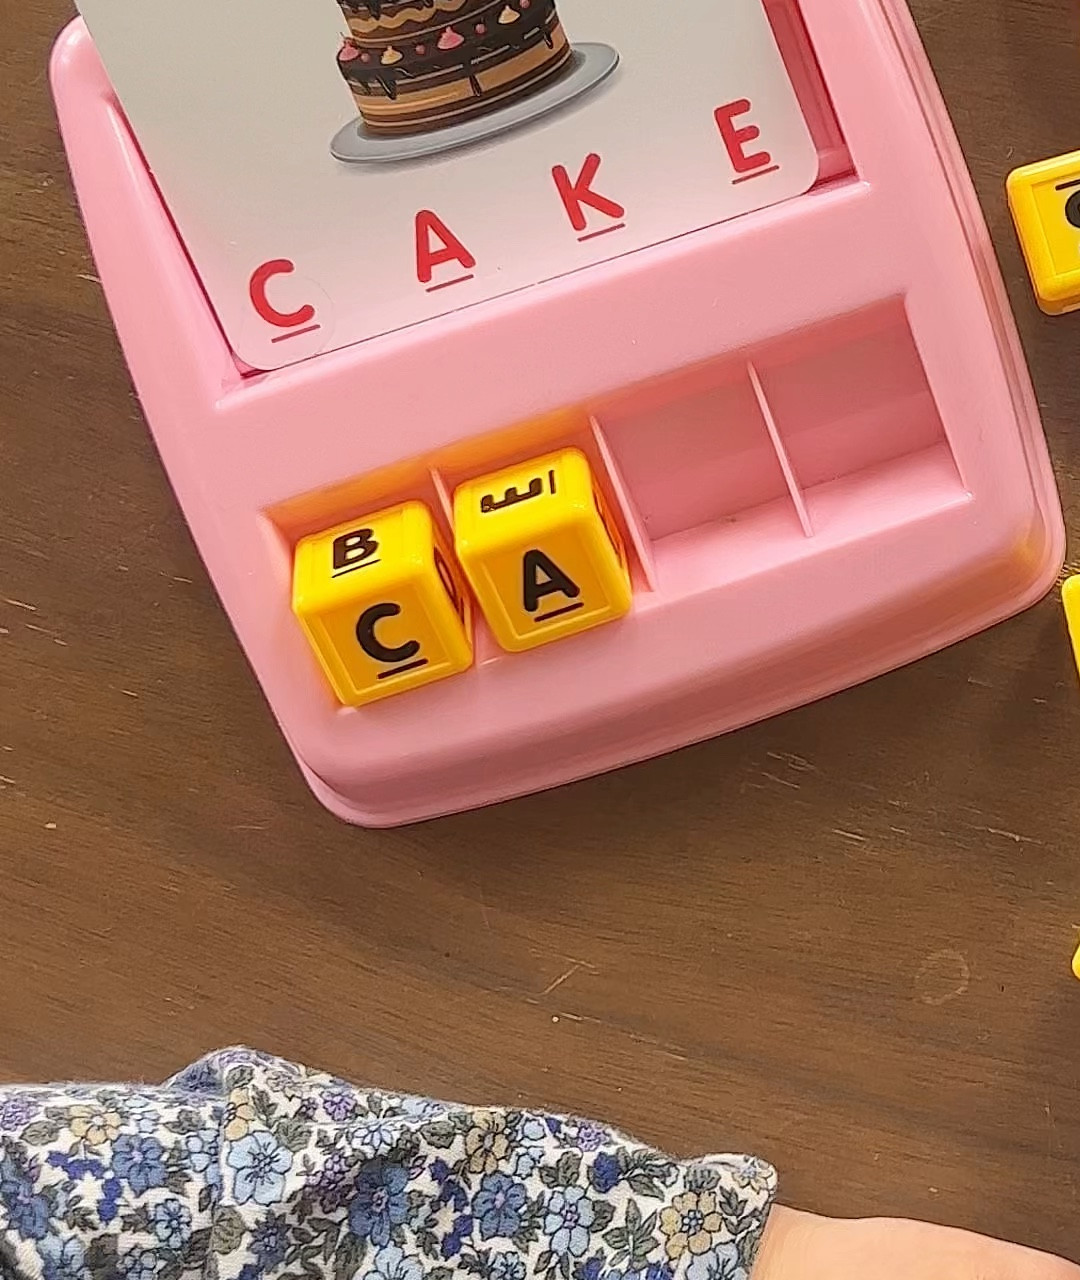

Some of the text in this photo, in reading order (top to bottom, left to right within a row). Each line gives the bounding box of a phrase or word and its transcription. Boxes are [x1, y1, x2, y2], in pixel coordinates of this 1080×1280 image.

[332, 527, 379, 570] B
[523, 549, 580, 612] A
[356, 602, 421, 663] C
